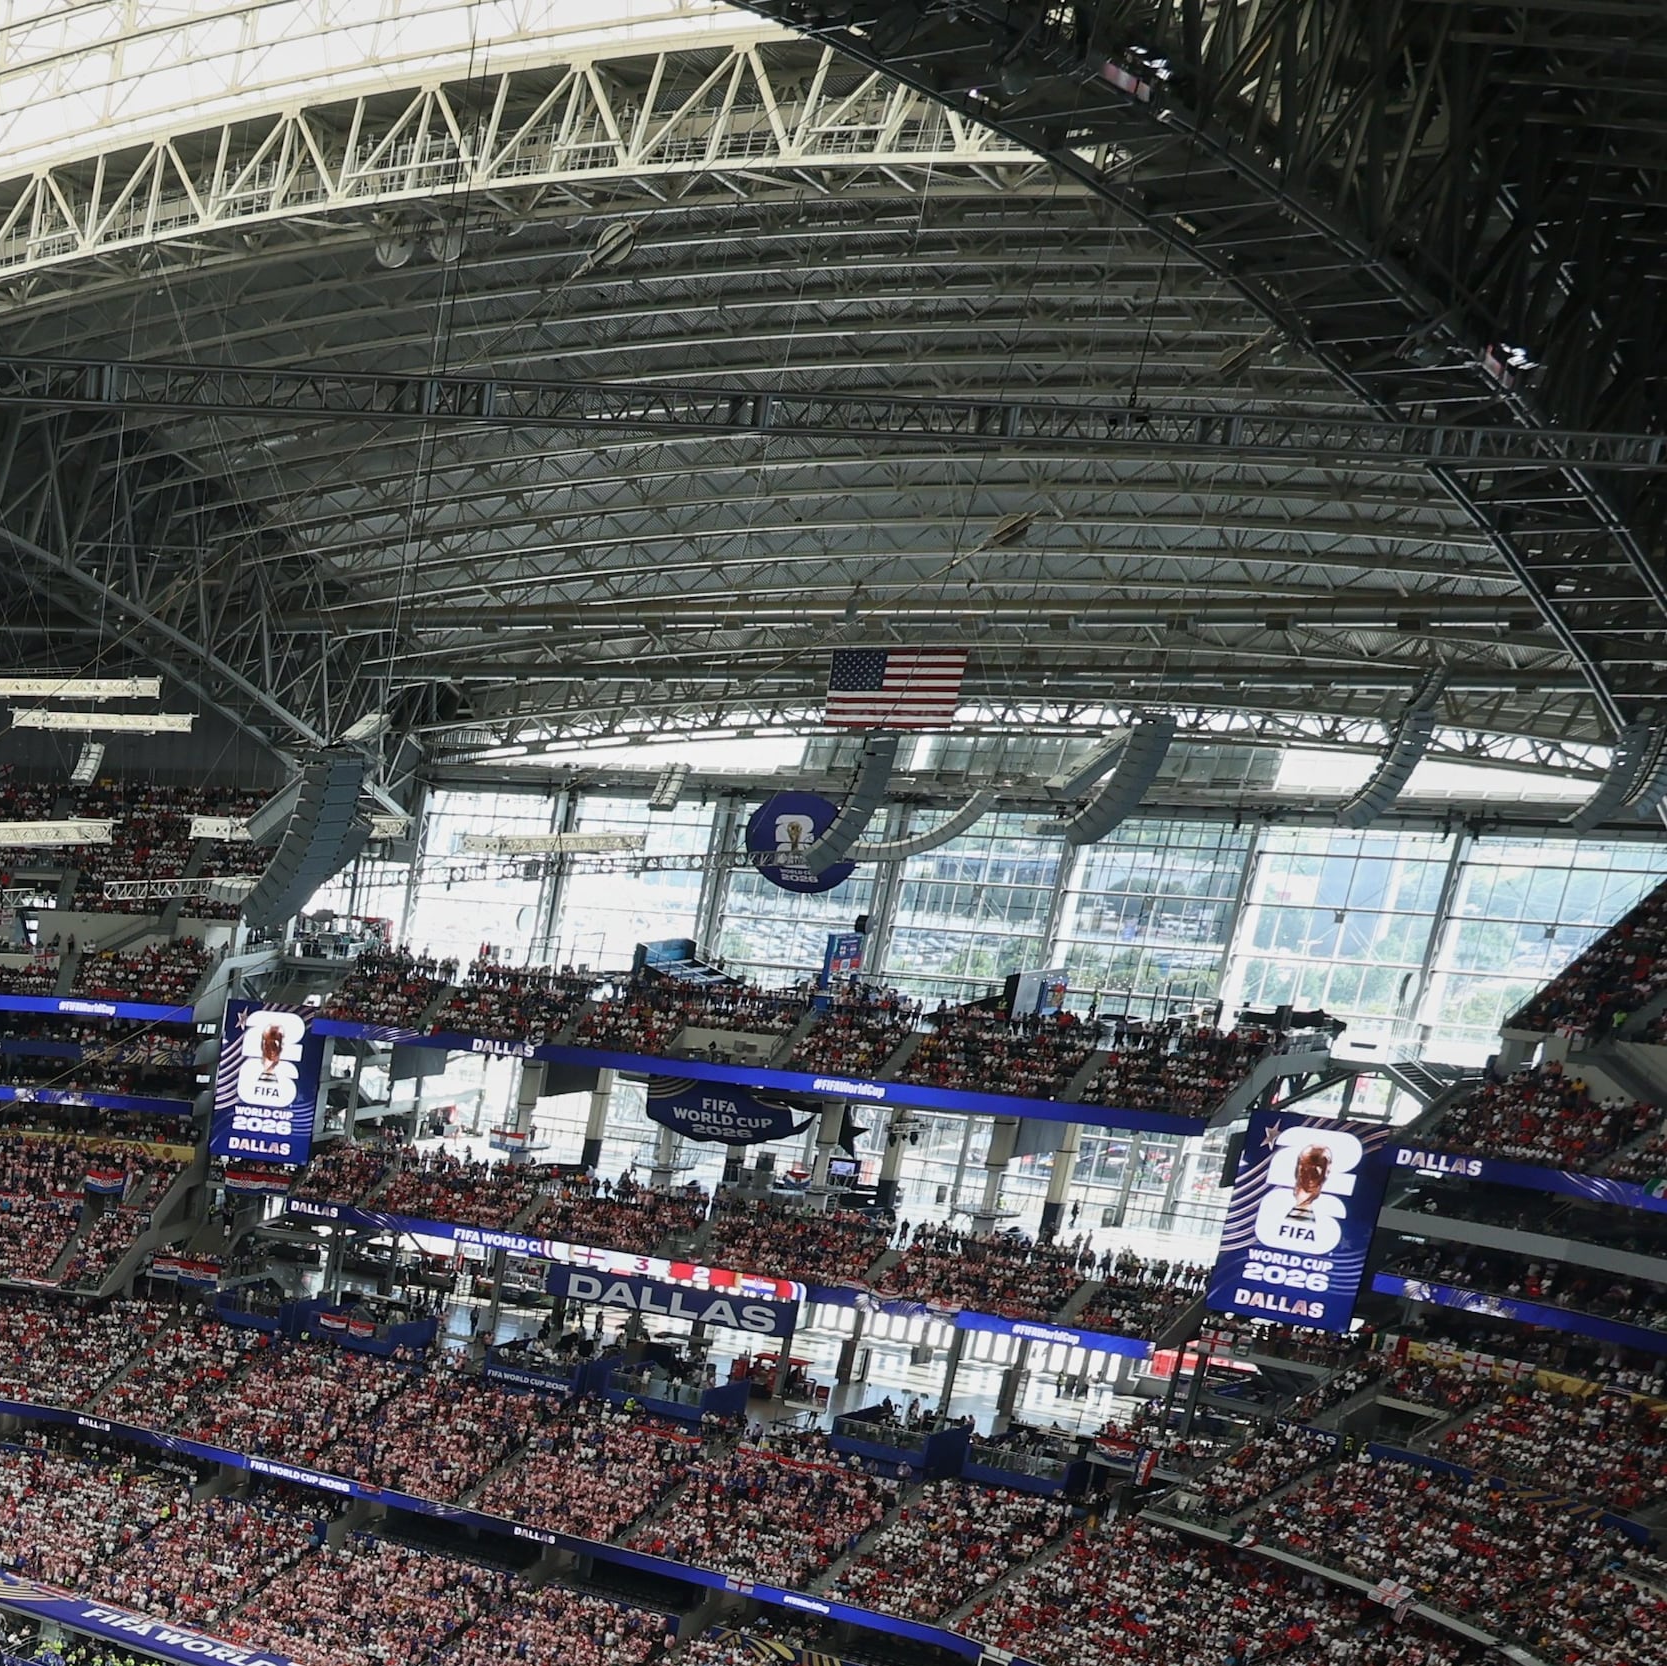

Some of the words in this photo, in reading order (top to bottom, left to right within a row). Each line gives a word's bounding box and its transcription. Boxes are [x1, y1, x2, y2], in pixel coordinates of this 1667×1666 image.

[472, 1037, 534, 1057] DALLAS
[253, 1085, 280, 1099] FIFA
[814, 1077, 885, 1099] #FIFAWorldCup
[234, 1105, 268, 1119] WORLD
[270, 1110, 293, 1120] CUP
[701, 1098, 737, 1115] FIFA
[233, 1116, 293, 1135] 2026
[673, 1105, 734, 1127] WORLD
[737, 1117, 772, 1132] CUP
[689, 1123, 755, 1141] 2026
[229, 1137, 290, 1156] DALLAS
[1396, 1149, 1482, 1177] DALLAS
[291, 1199, 338, 1217] DALLAS
[452, 1228, 483, 1246] FIFA
[483, 1231, 526, 1251] WORLD
[1277, 1223, 1315, 1243] FIFA
[634, 1257, 649, 1272] 3
[1247, 1247, 1299, 1268] WORLD
[1301, 1259, 1333, 1273] CUP
[1241, 1260, 1331, 1294] 2026
[566, 1273, 778, 1334] DALLAS
[1234, 1289, 1324, 1318] DALLAS
[487, 1369, 503, 1379] FIFA
[504, 1372, 527, 1384] WORLD
[528, 1377, 544, 1387] CUP
[78, 1417, 110, 1431] DALLAS
[250, 1460, 268, 1472] FIFA
[269, 1464, 299, 1480] WORLD
[300, 1471, 318, 1484] CUP
[319, 1476, 351, 1492] 2026
[514, 1527, 556, 1543] DALLAS
[80, 1607, 154, 1638] FIFA
